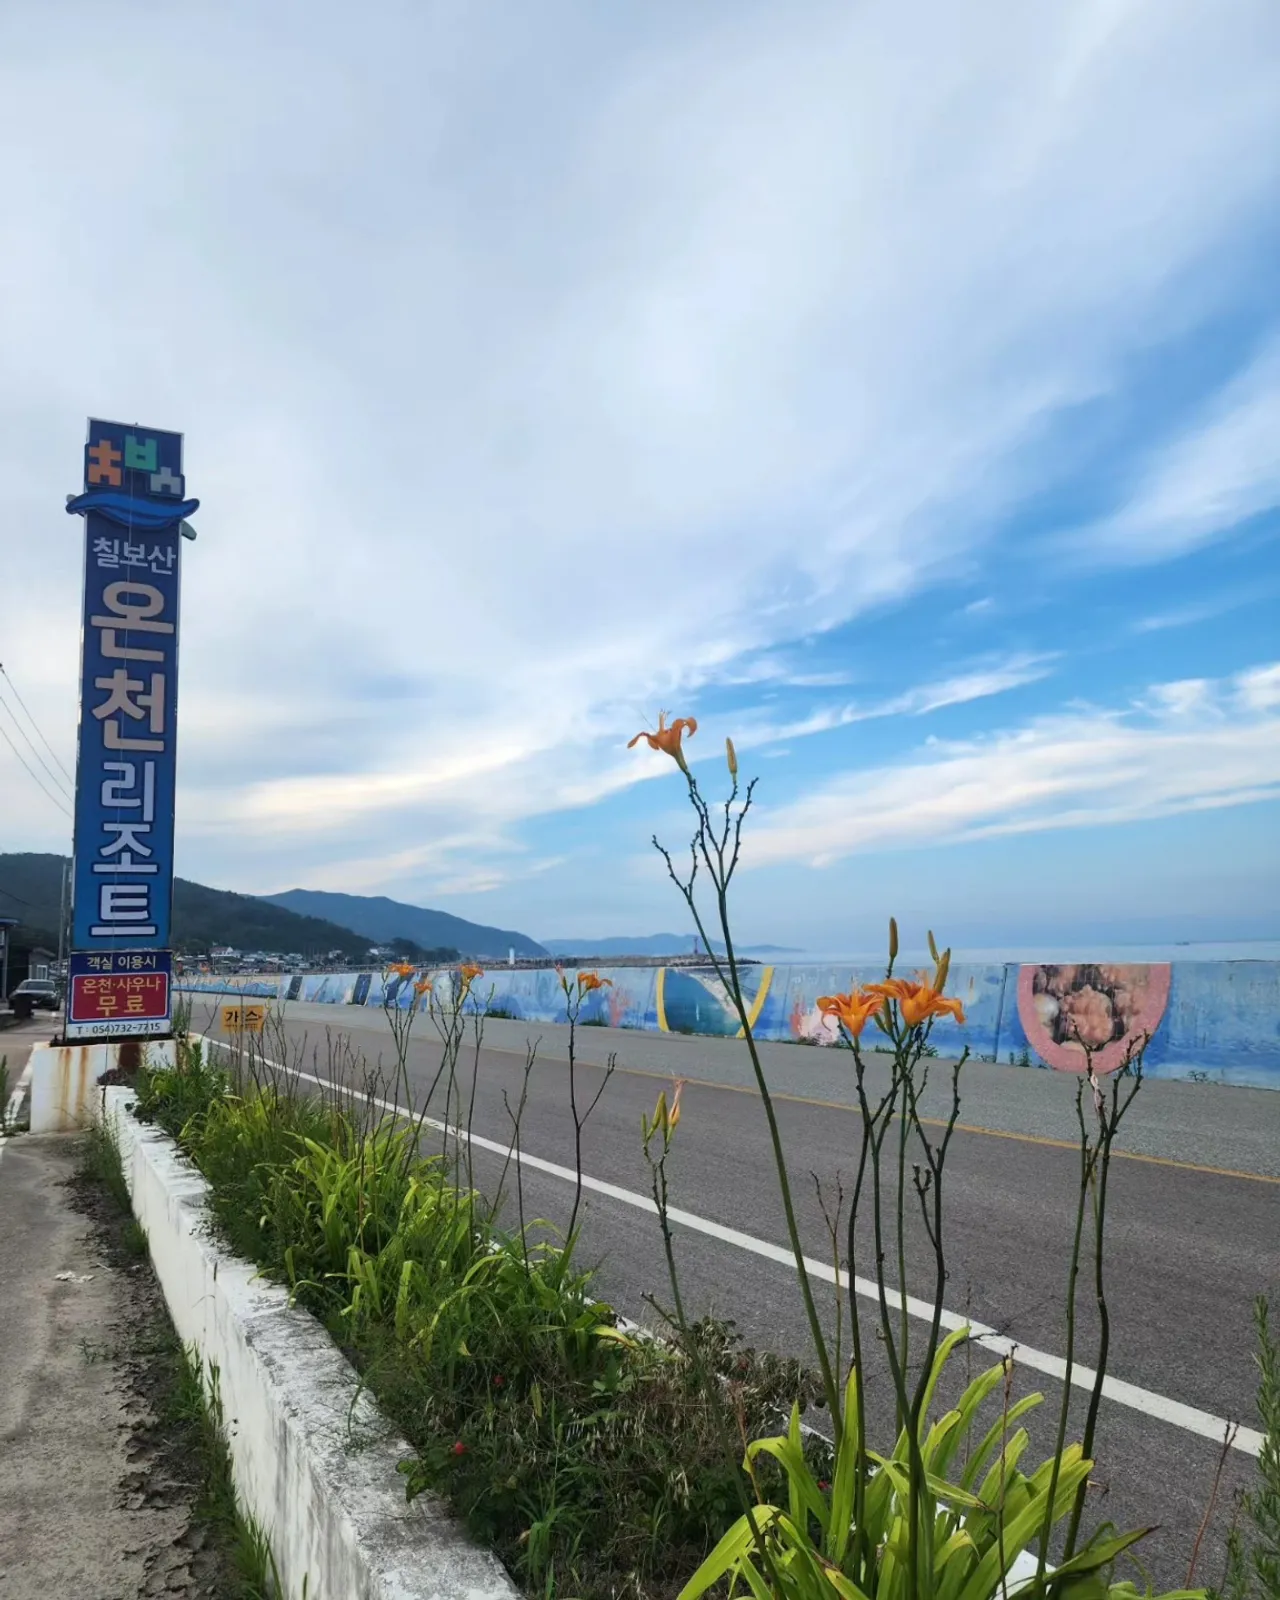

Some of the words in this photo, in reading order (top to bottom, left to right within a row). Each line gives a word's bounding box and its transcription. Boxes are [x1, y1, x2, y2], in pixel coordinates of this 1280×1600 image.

[93, 537, 176, 575] 칠보산
[87, 956, 113, 971] 객실
[118, 955, 156, 969] 이용시
